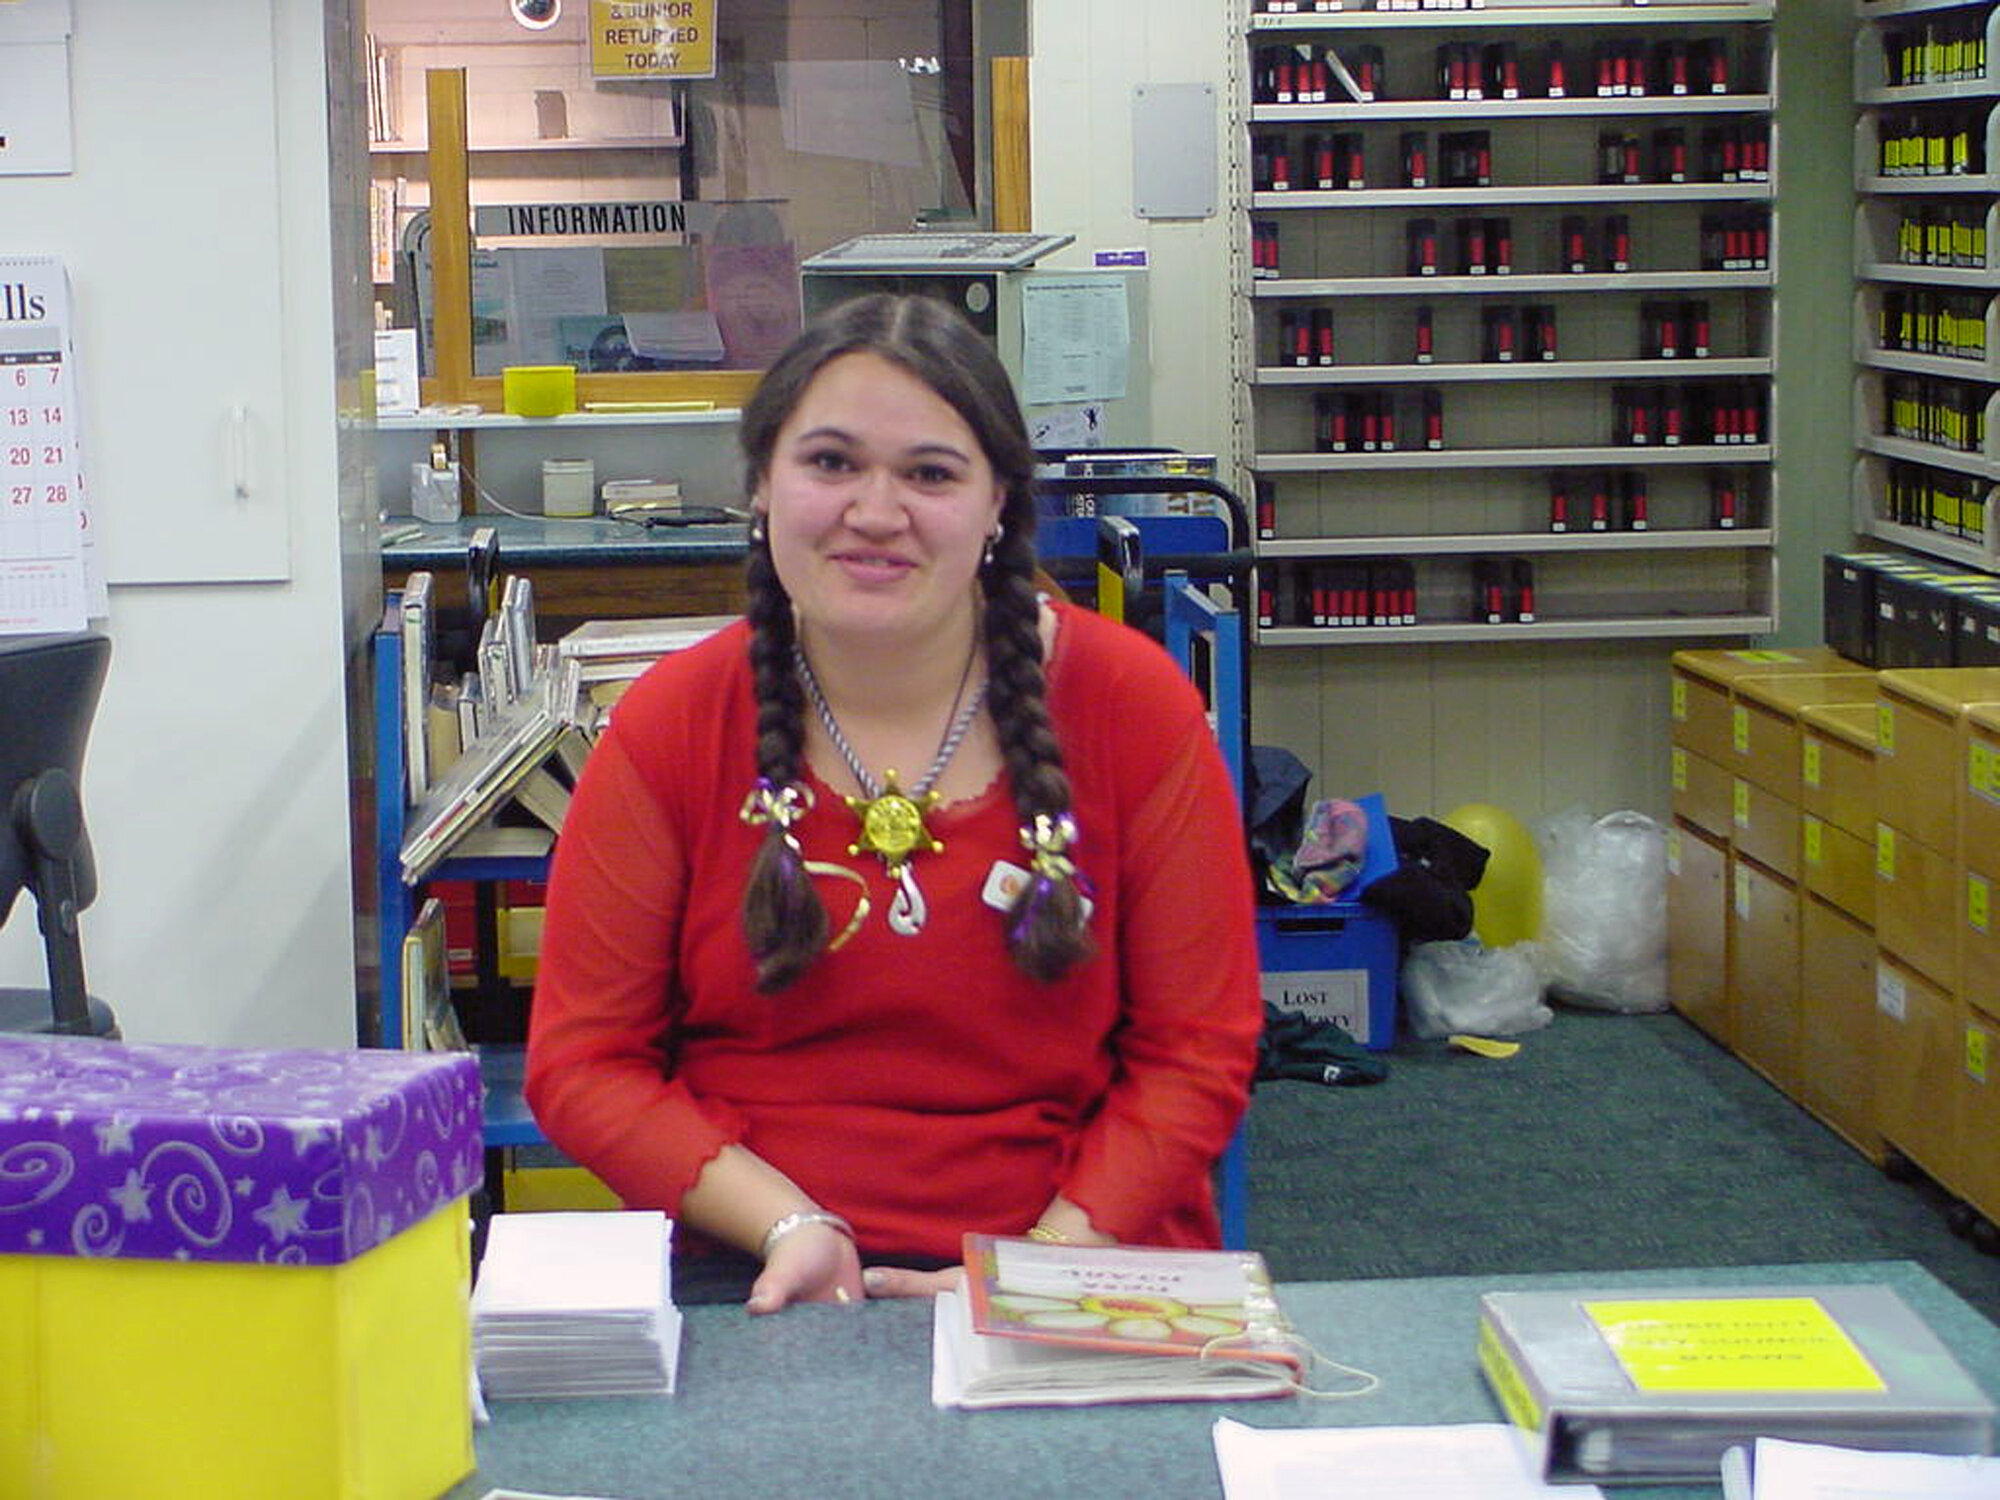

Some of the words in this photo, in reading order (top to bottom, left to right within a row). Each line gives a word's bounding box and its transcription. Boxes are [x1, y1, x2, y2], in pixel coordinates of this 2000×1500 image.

[625, 2, 692, 18] JUNIOR
[625, 53, 680, 68] TODAY
[508, 204, 685, 234] INFORMATION
[0, 284, 46, 320] lls
[16, 368, 26, 387] 6
[50, 367, 60, 384] 7
[9, 409, 29, 426] 13
[44, 407, 62, 424] 14
[10, 448, 31, 465] 20
[44, 446, 63, 463] 21
[12, 487, 32, 504] 27
[46, 486, 67, 502] 28
[1283, 989, 1328, 1006] LOST
